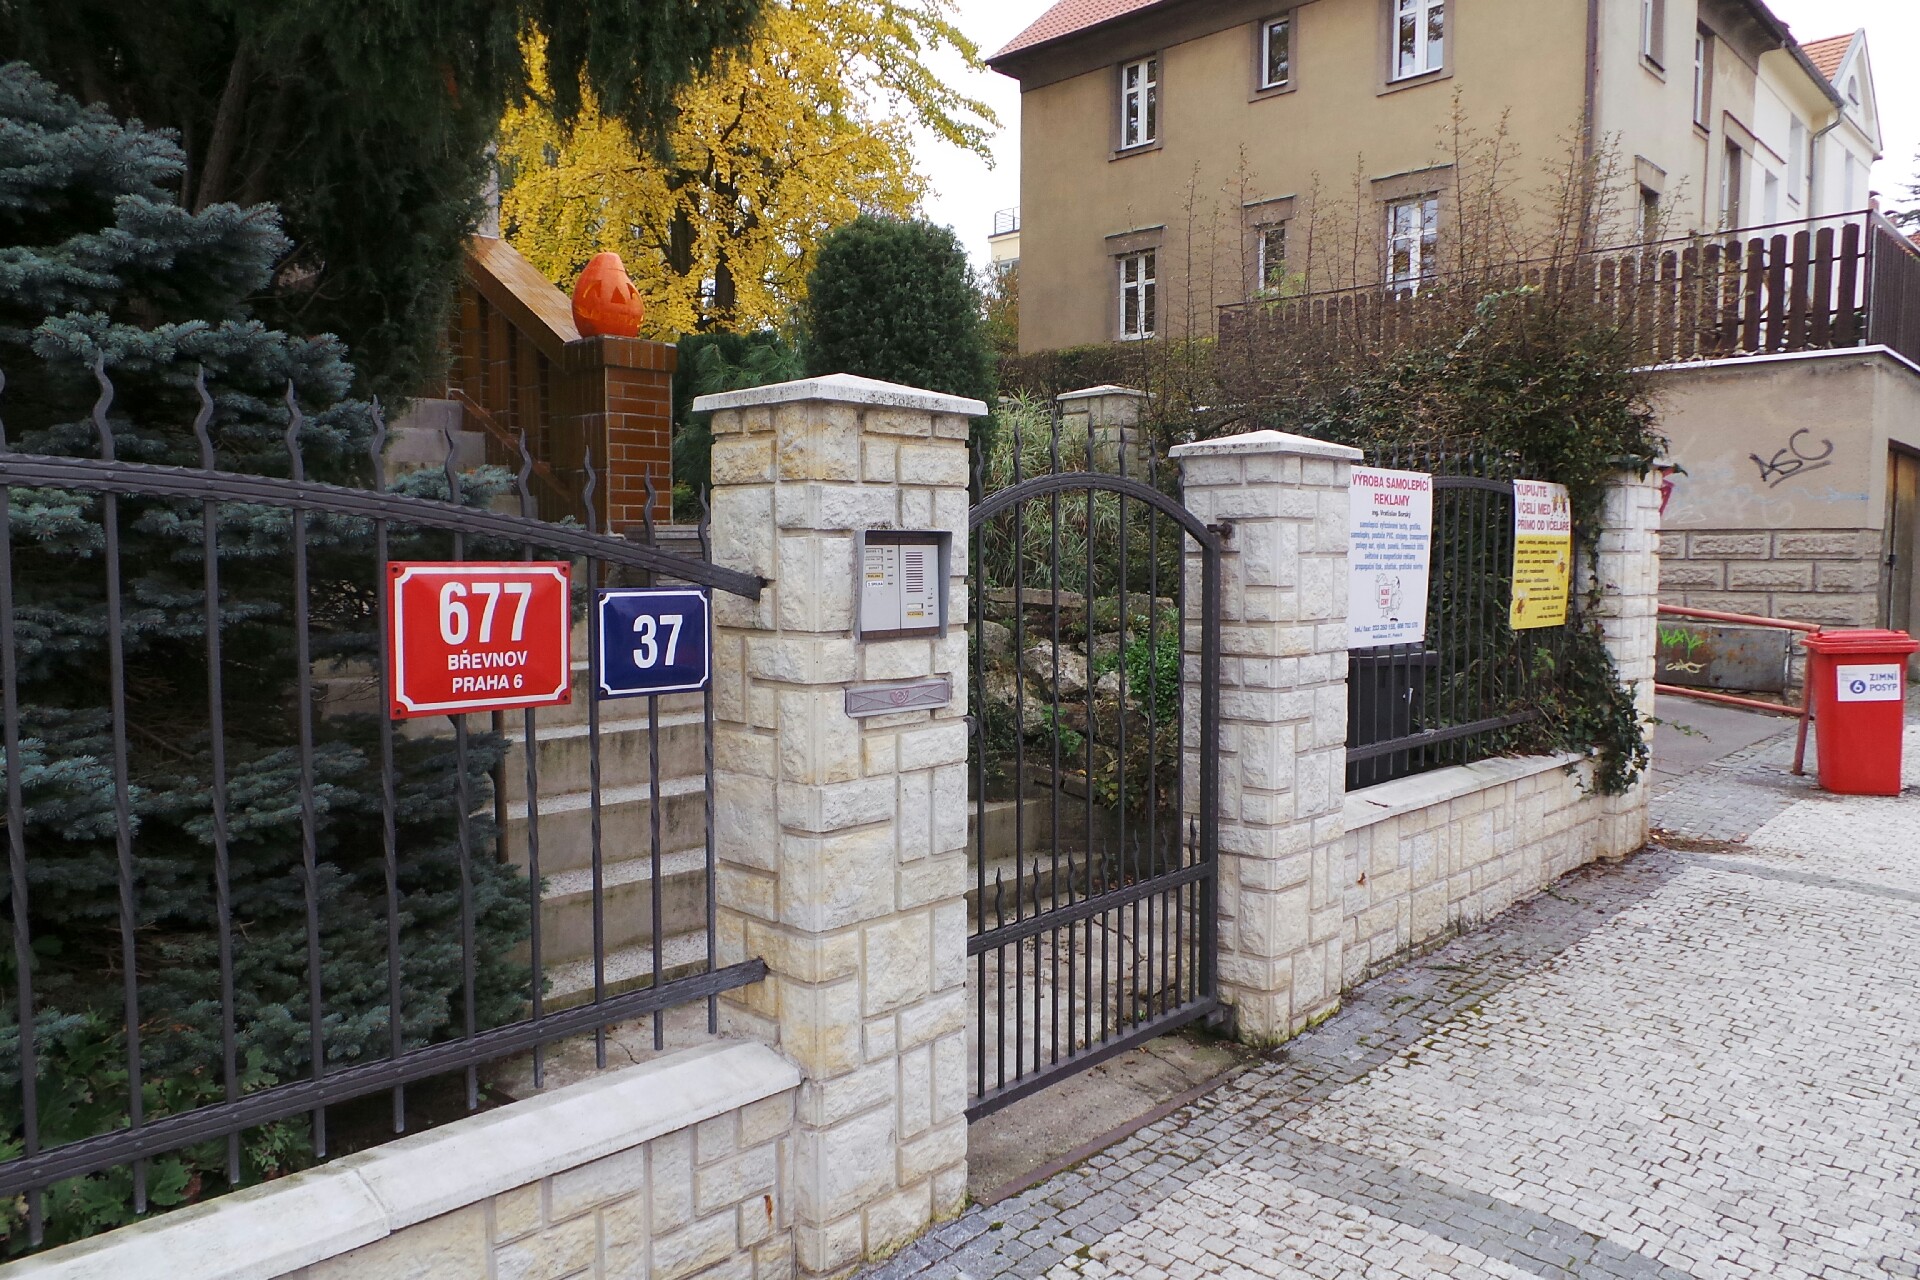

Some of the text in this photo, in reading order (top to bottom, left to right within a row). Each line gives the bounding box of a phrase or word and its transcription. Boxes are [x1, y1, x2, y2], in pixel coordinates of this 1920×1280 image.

[1352, 471, 1429, 492] VÝROBA SAMOLEPÍCÍ
[1374, 493, 1410, 506] REKLAMY
[1517, 484, 1547, 498] KUPUJTE
[1518, 498, 1551, 515] VČELÍ MED
[1518, 516, 1569, 531] PŘÍMO OD VČELAŘE
[439, 581, 532, 645] 677
[633, 614, 683, 669] 37
[447, 649, 528, 670] BŘEVNOV
[452, 673, 523, 694] PRAHA 6
[1869, 671, 1897, 681] ZIMNÍ
[1869, 683, 1898, 692] POSYP
